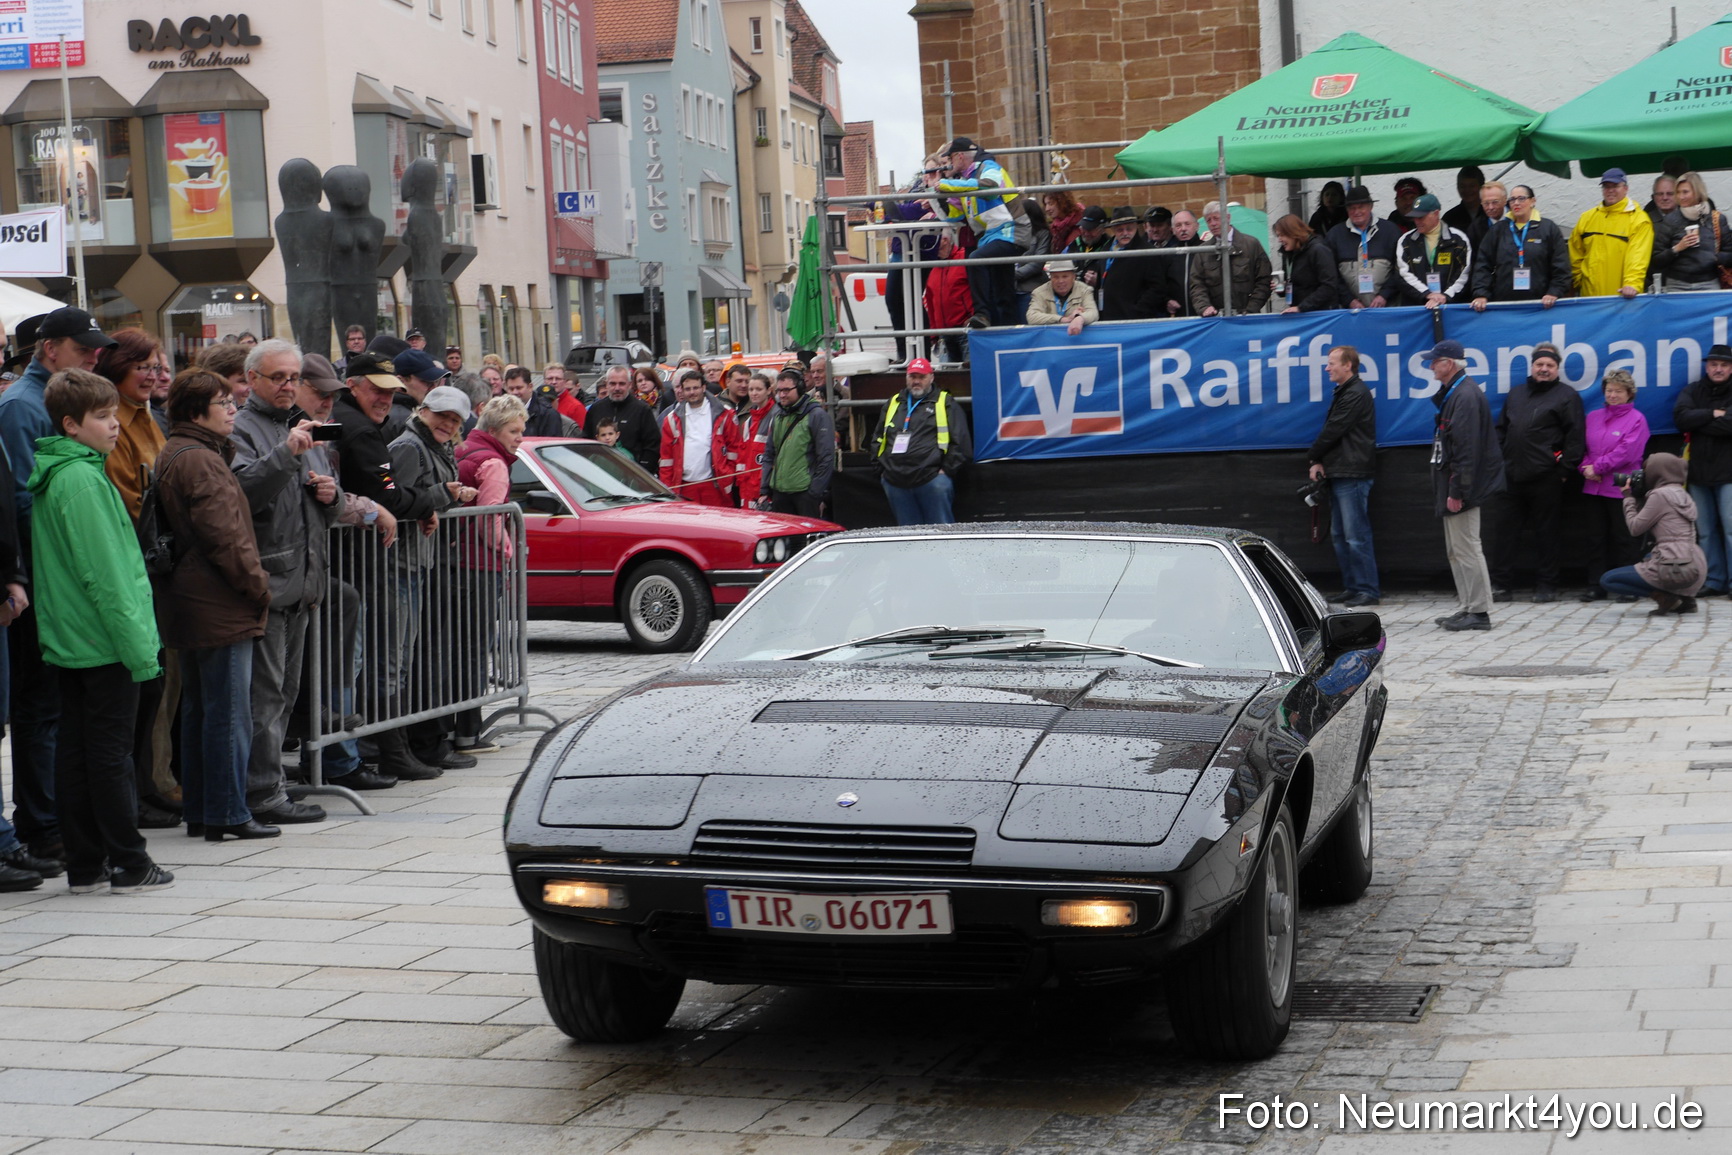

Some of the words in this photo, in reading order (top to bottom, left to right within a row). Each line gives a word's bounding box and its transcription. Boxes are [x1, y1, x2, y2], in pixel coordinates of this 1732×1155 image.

[127, 13, 262, 52] RACKL
[148, 60, 175, 70] am
[178, 50, 251, 69] Rathaus
[1265, 98, 1392, 116] Neumarkter
[1236, 106, 1411, 131] Lammsbräu
[40, 127, 55, 138] 100
[57, 124, 83, 137] Jare
[1257, 133, 1290, 141] FEINE
[1292, 126, 1379, 138] ÖKOLOGISCHE
[1382, 122, 1409, 130] BIER
[642, 93, 670, 233] satzke
[1, 219, 48, 244] nsel
[205, 302, 233, 317] RACKL
[715, 911, 726, 921] D
[731, 894, 796, 927] TIR
[825, 898, 938, 930] 06071
